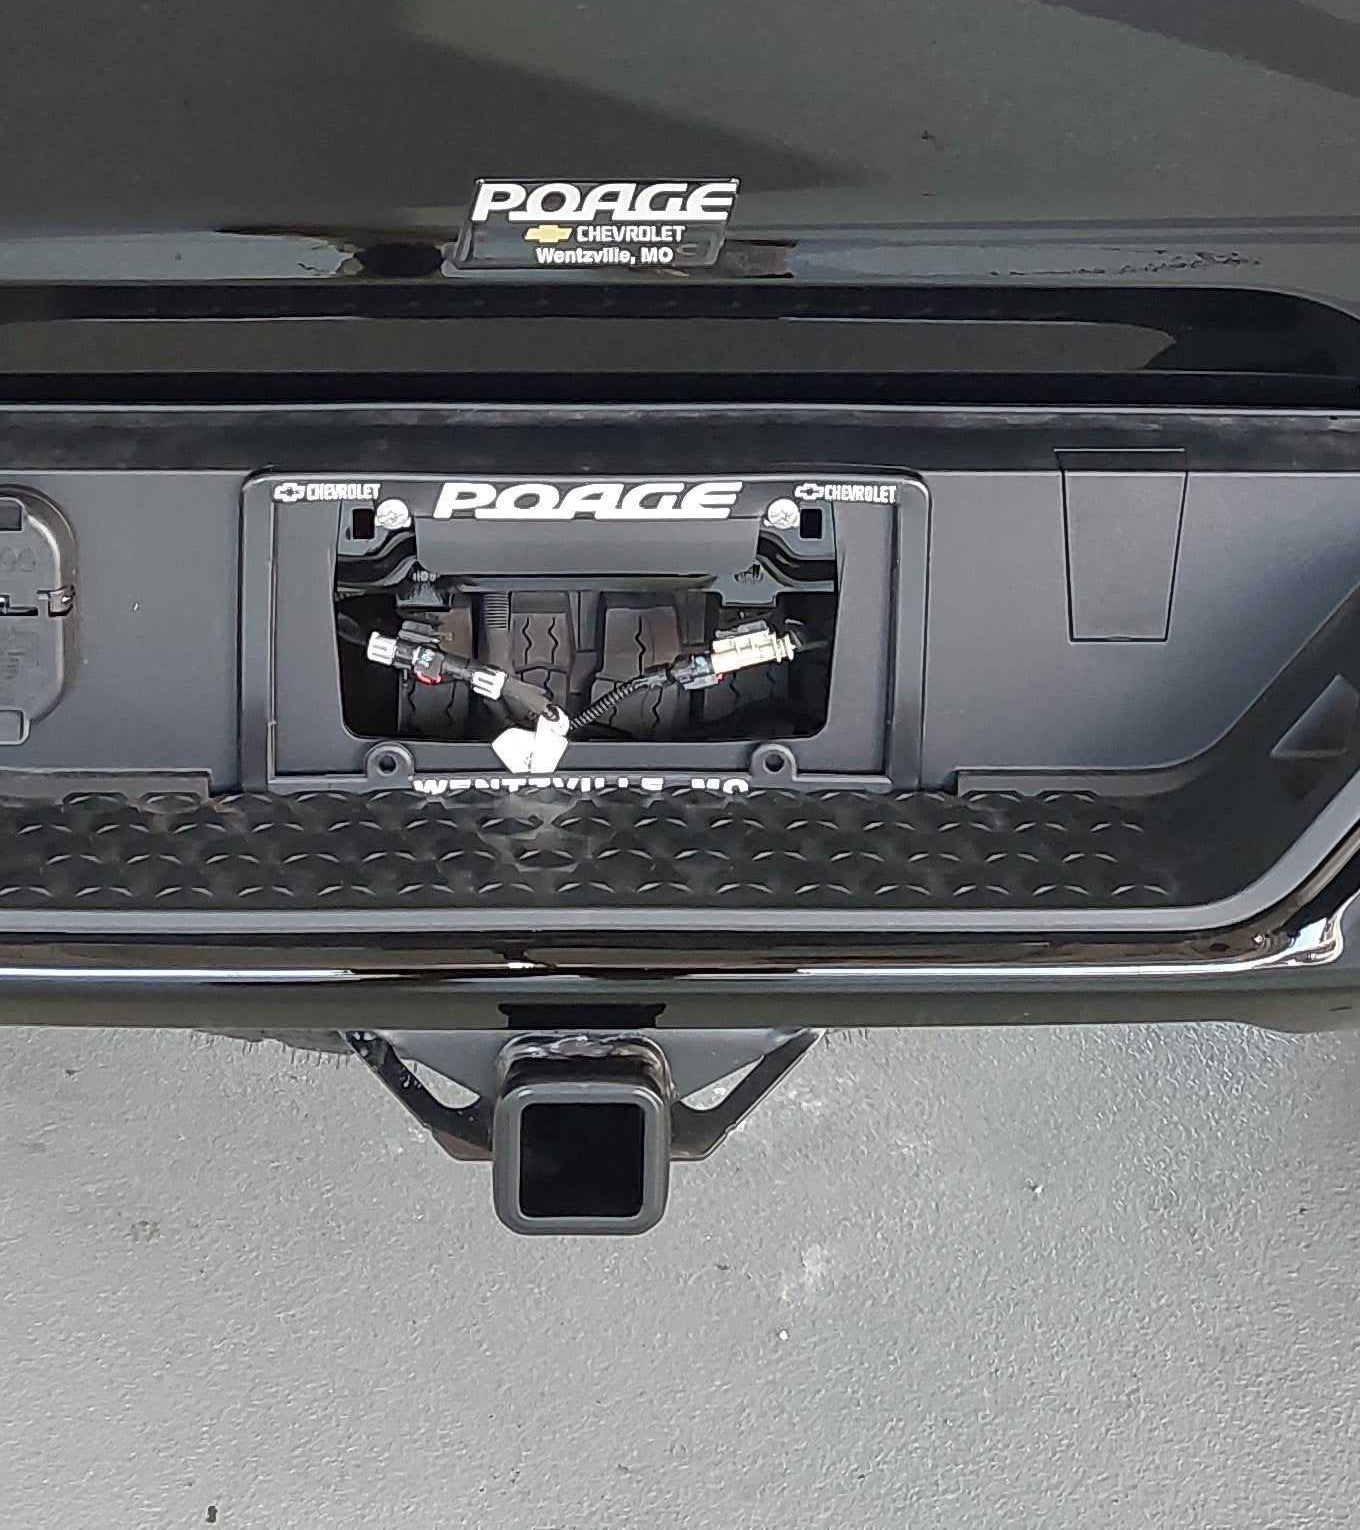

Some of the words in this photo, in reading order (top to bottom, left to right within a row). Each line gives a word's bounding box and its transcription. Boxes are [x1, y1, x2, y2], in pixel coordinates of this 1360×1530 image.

[471, 183, 737, 221] POAGE
[576, 225, 685, 242] CHEVROLET
[536, 247, 636, 265] Wentzville,
[641, 247, 674, 263] MO
[306, 483, 380, 501] CHEVROLET
[434, 482, 743, 520] POAGE
[824, 484, 897, 503] CHEVROLET
